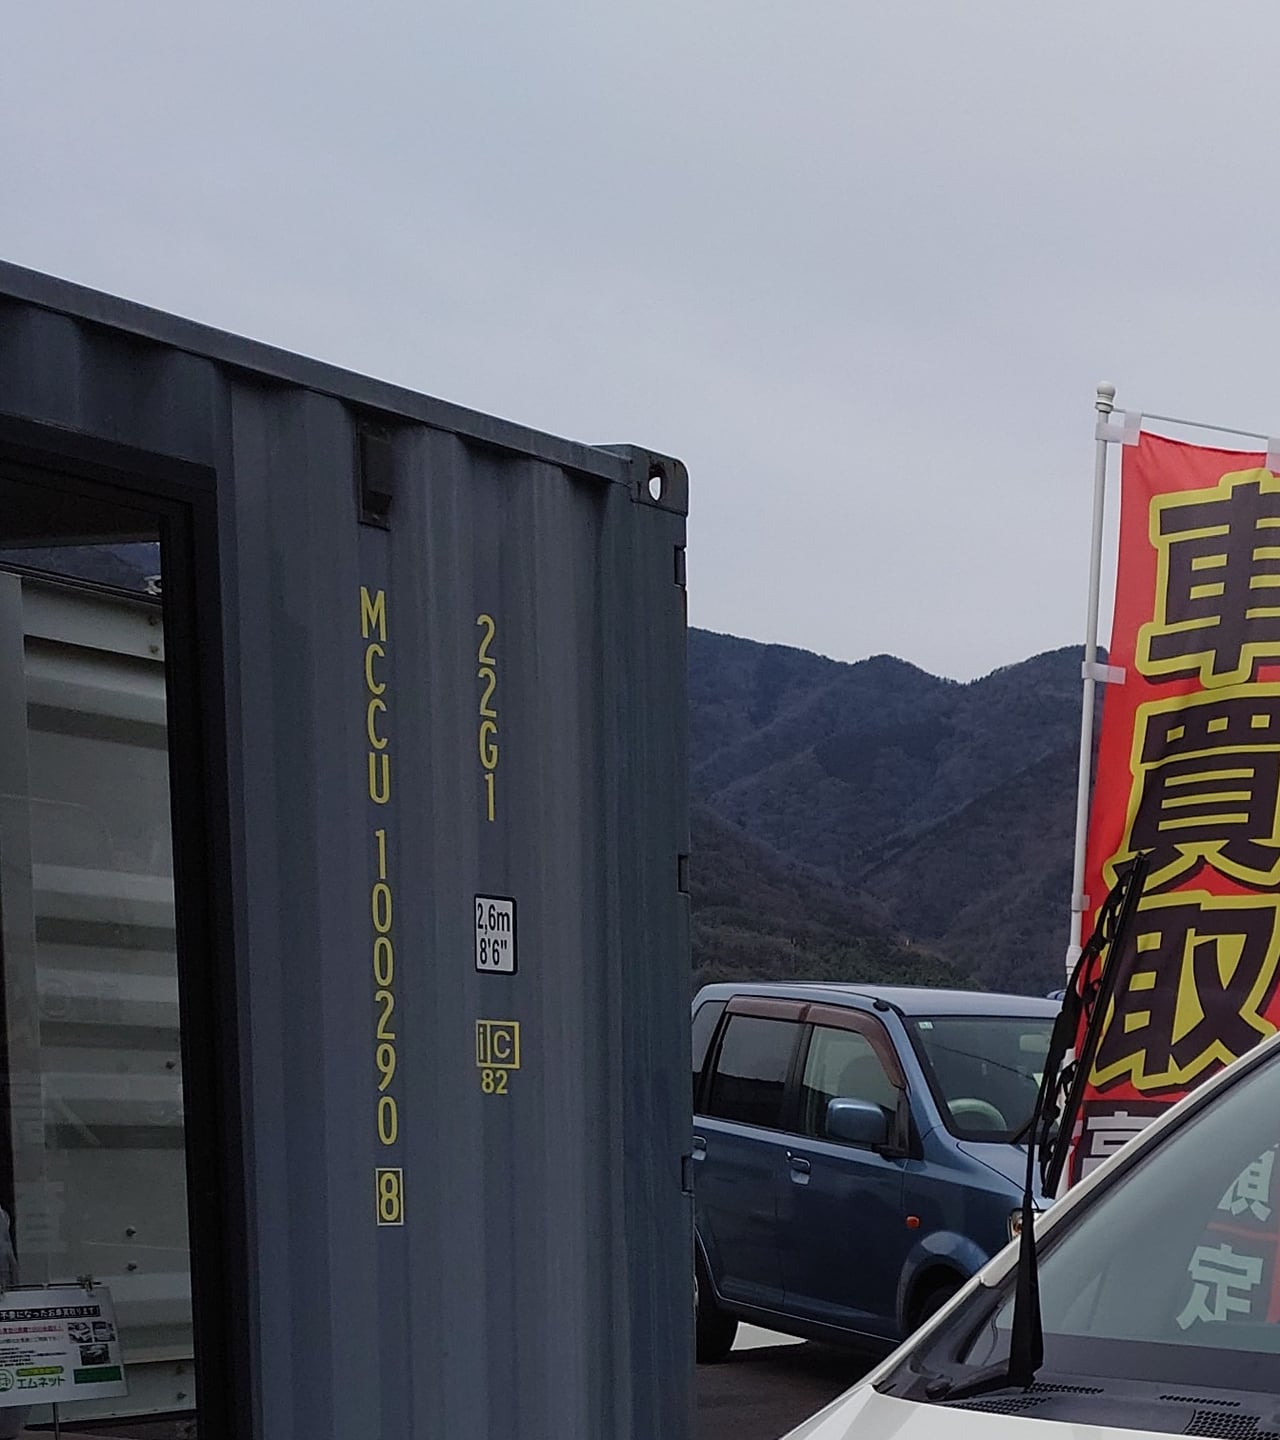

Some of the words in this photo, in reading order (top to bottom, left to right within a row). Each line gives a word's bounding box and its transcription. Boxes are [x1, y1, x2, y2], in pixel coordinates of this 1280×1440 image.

[360, 586, 390, 804] MCCU
[476, 613, 498, 822] 22G1
[372, 829, 398, 1145] 100290
[477, 902, 511, 934] 2,6m
[481, 1069, 508, 1095] 82
